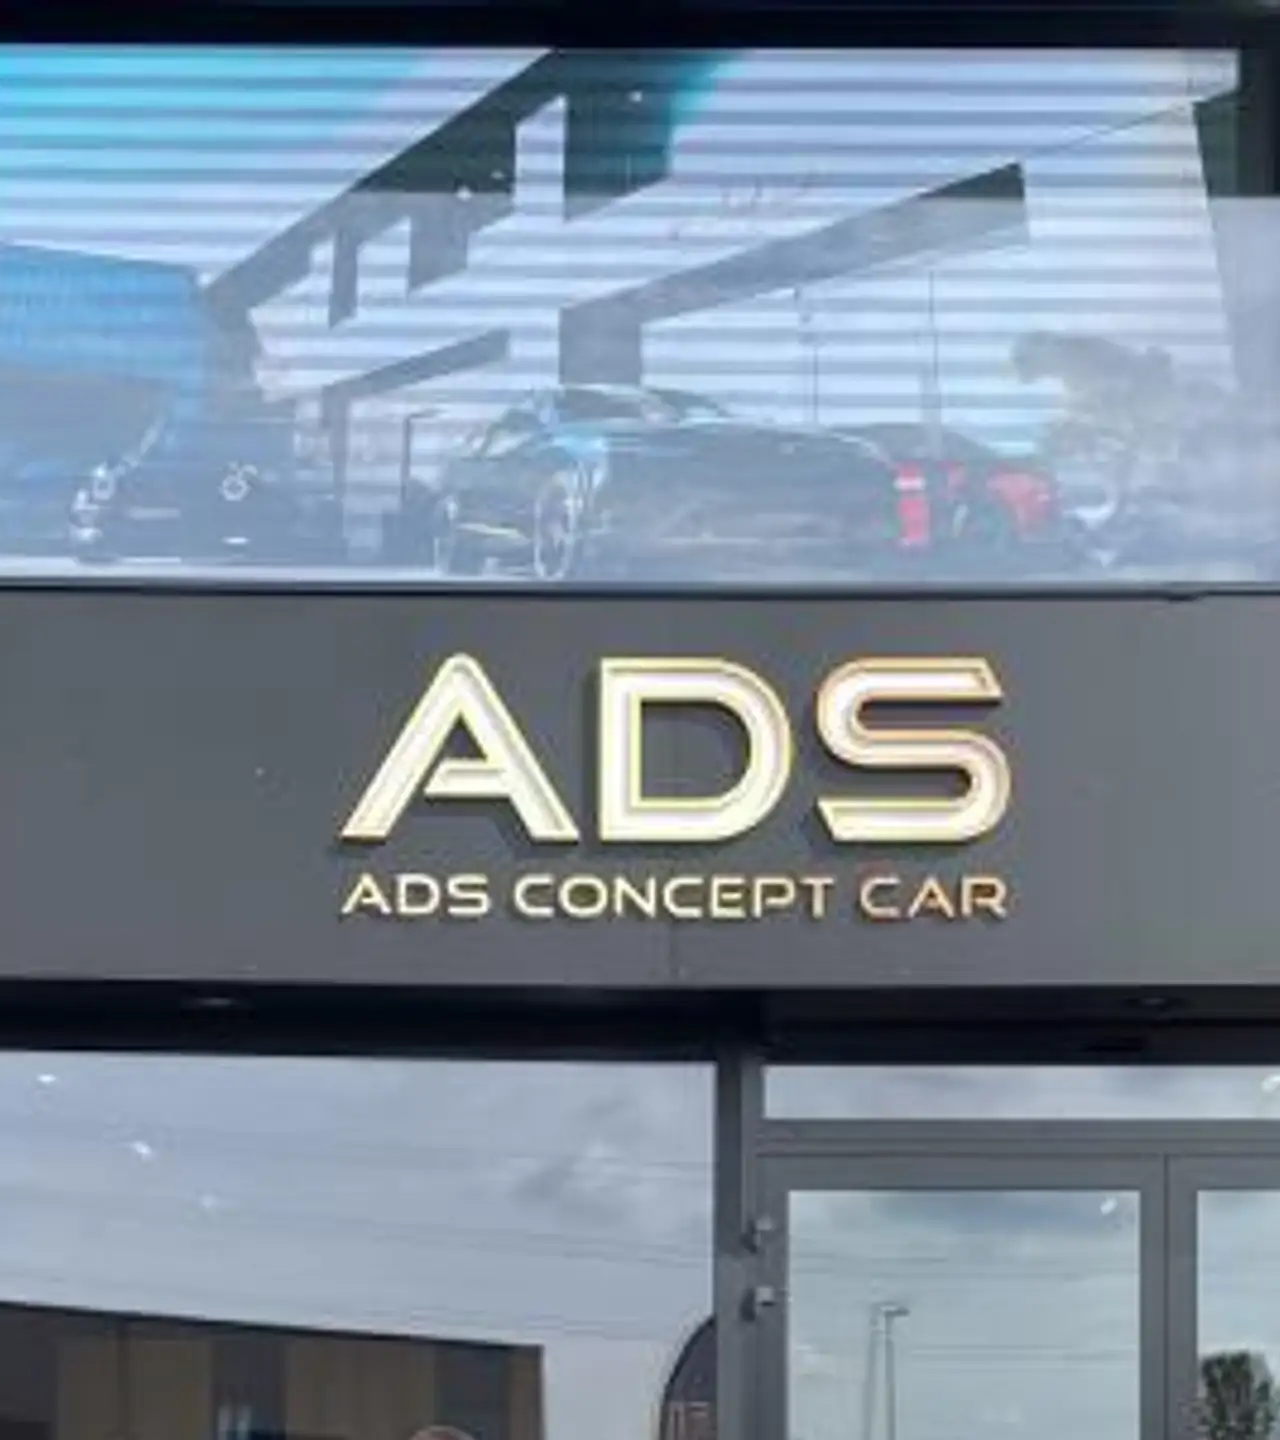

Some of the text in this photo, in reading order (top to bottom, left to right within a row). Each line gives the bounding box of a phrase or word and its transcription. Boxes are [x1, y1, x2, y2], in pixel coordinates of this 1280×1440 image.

[340, 652, 1012, 842] ADS
[340, 872, 1009, 919] ADS CONCEPT CAR
